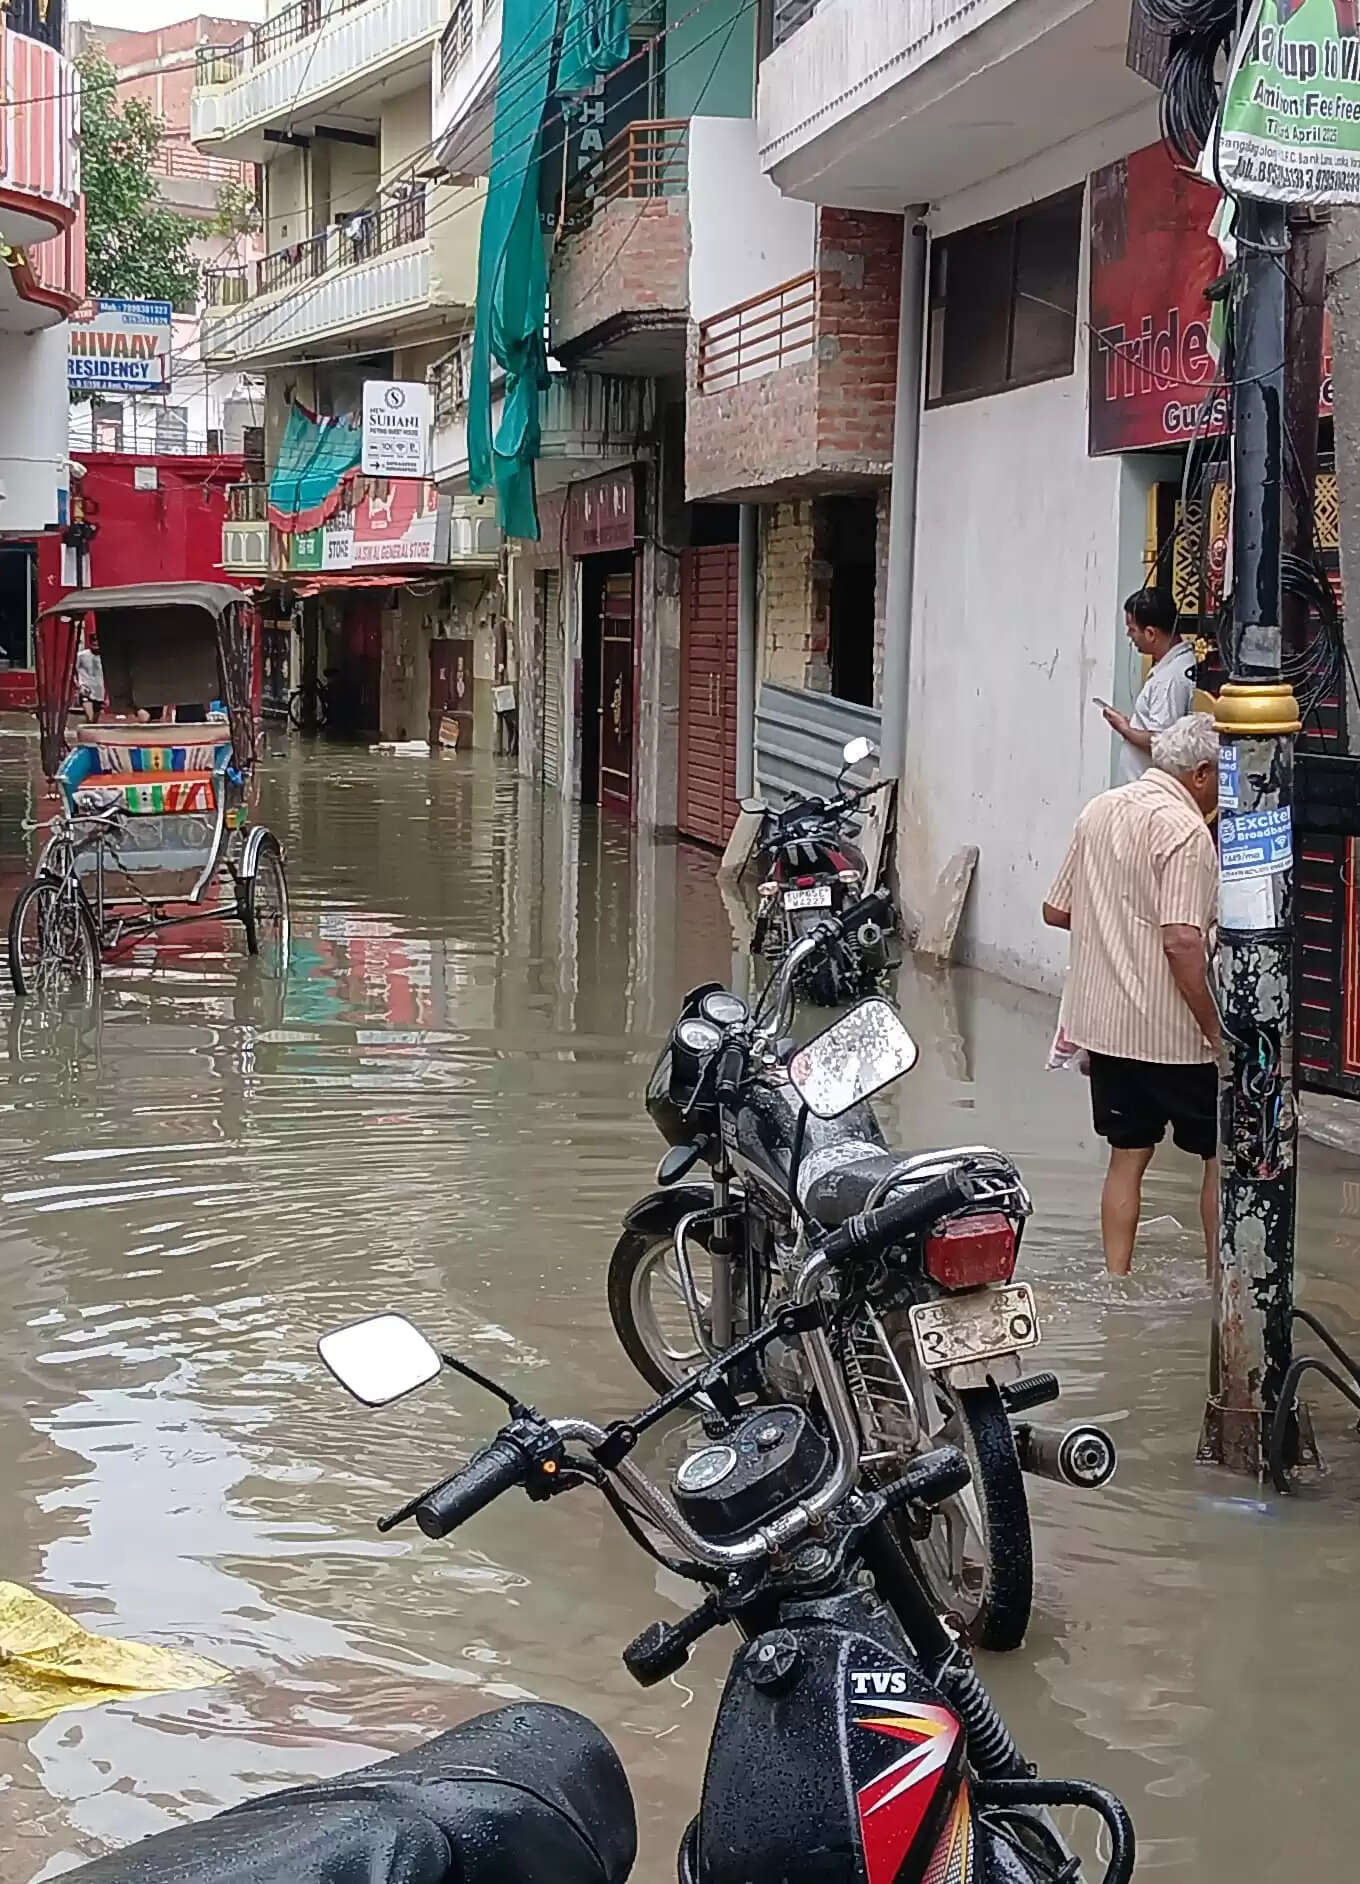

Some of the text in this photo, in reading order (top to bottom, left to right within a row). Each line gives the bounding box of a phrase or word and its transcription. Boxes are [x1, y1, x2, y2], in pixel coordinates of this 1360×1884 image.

[1292, 127, 1321, 144] April
[70, 331, 159, 360] HIVAAY
[1098, 307, 1210, 401] Tride
[68, 359, 149, 378] RESIDENCY
[369, 415, 419, 427] SUHANI
[1163, 400, 1229, 434] Gues
[328, 540, 349, 559] STORE
[409, 541, 430, 558] STORE
[1235, 805, 1290, 832] Excitel
[851, 1672, 907, 1693] TVS
